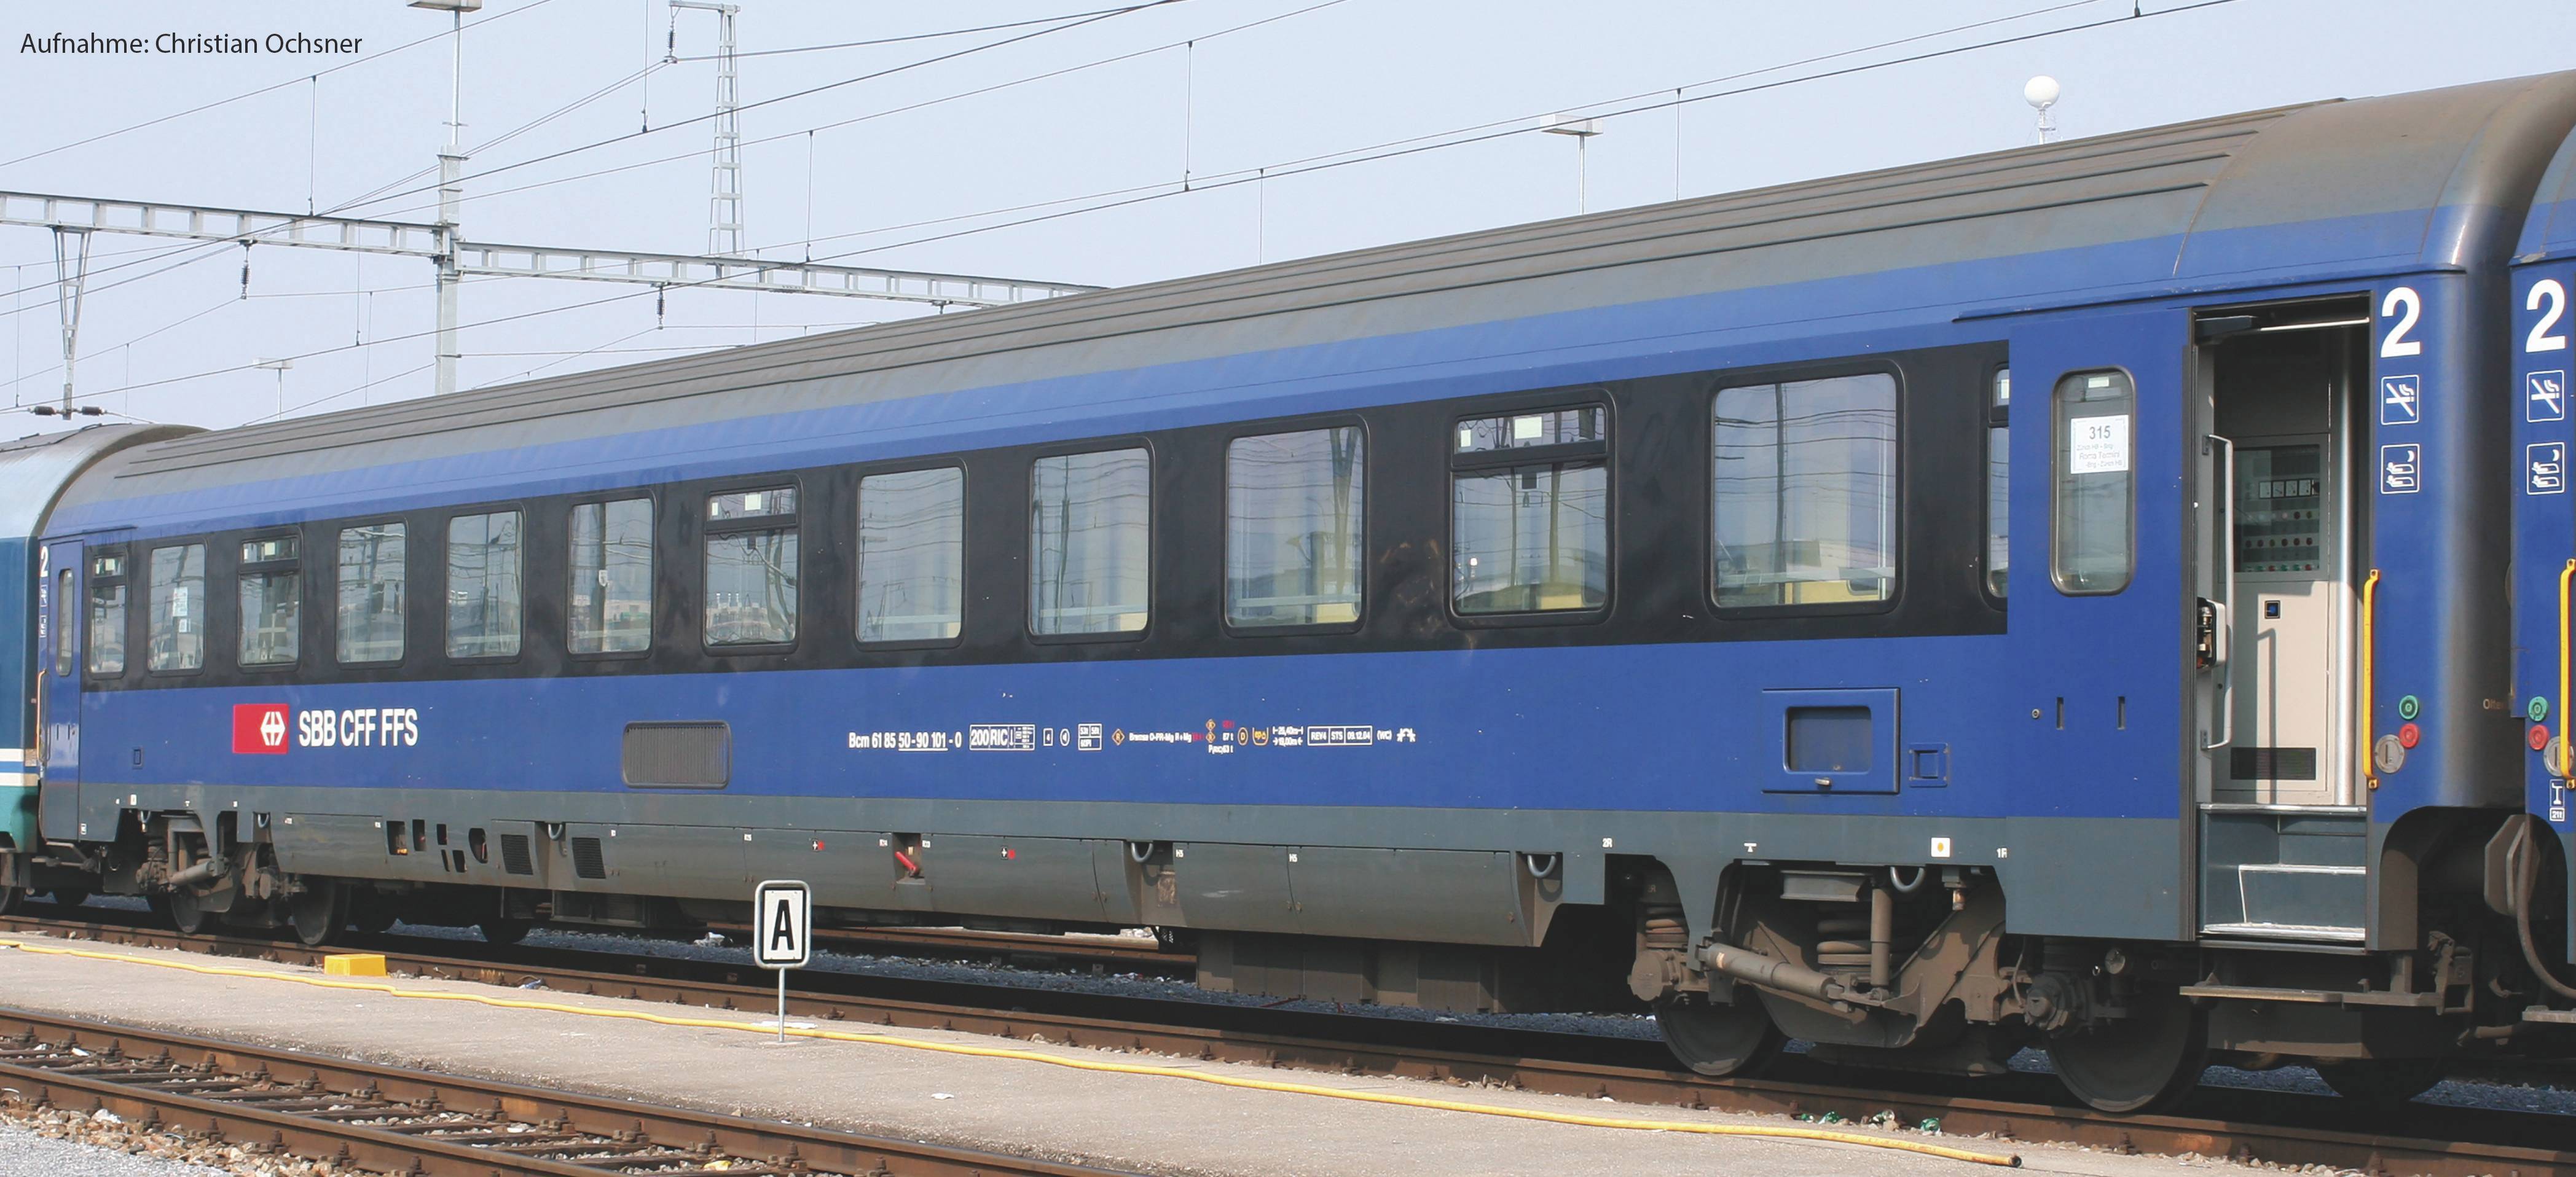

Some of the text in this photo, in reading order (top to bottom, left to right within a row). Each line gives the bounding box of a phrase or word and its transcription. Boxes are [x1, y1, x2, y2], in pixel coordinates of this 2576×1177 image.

[2381, 286, 2421, 358] 2
[2526, 279, 2566, 353] 2
[2089, 425, 2111, 440] 315
[39, 545, 48, 577] 2
[299, 708, 418, 746] SBB CFF FFS
[970, 729, 989, 746] 200
[990, 729, 1008, 746] RIC
[849, 732, 870, 748] Bcm
[871, 732, 882, 748] 61
[884, 732, 896, 748] 85
[1602, 837, 1613, 848] 2R
[1997, 848, 2008, 858] 1R
[770, 899, 795, 950] A
